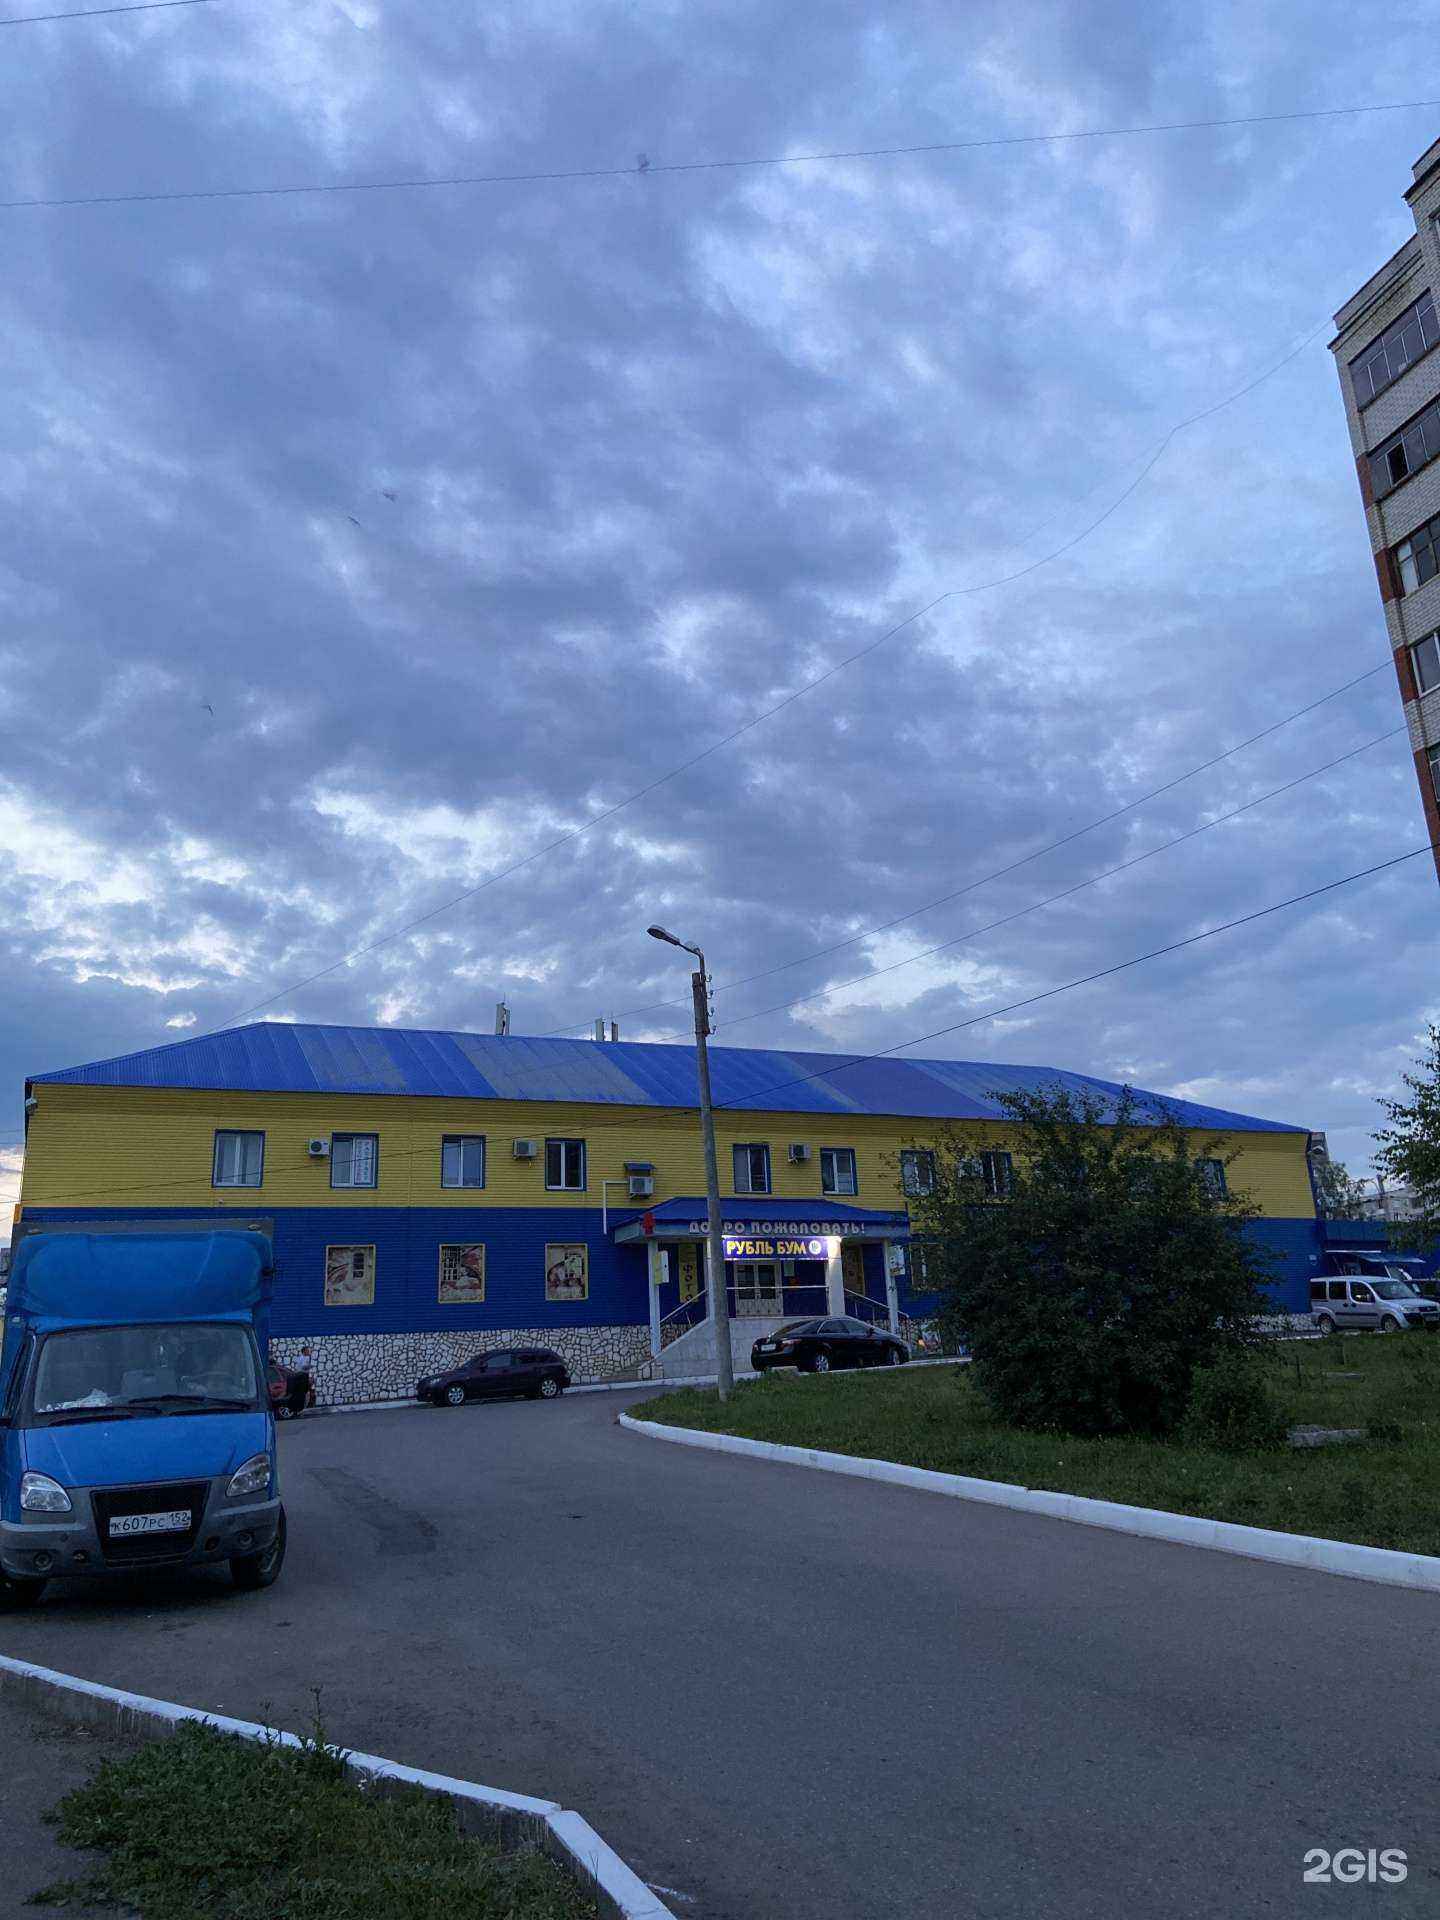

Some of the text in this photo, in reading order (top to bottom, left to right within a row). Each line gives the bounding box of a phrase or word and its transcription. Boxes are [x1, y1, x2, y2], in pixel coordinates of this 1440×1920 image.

[689, 1221, 865, 1234] ДОРО ПОЖАЛОВАТЬ!
[726, 1240, 807, 1255] РУБЛЬ БУМ
